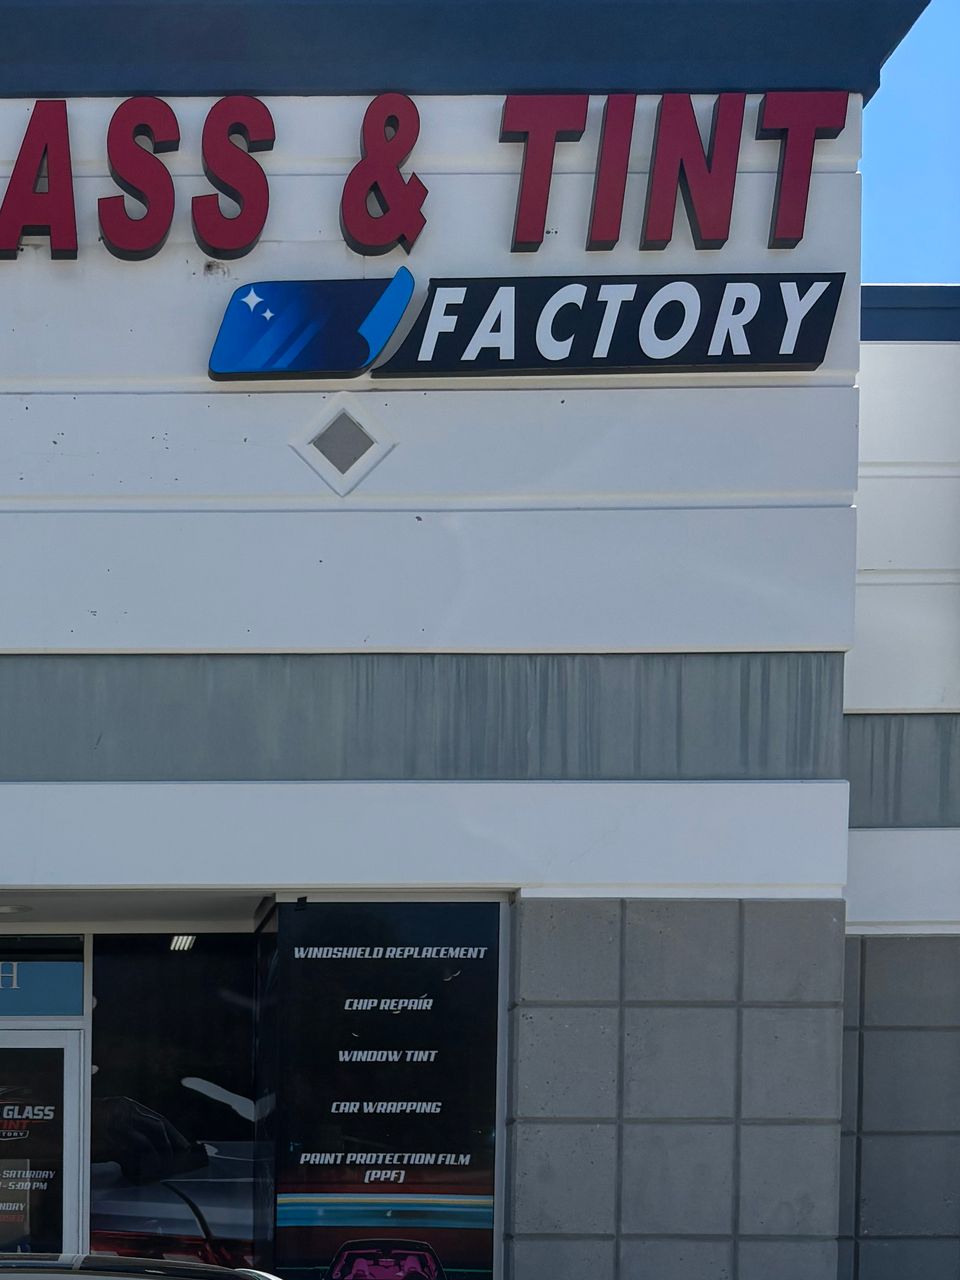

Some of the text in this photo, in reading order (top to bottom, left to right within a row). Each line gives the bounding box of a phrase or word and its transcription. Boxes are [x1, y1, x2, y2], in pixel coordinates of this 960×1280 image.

[340, 92, 430, 256] &
[498, 91, 850, 252] TINT
[418, 281, 832, 362] FACTORY
[294, 946, 488, 959] WINDSHIELD REPLACEMENT
[344, 998, 434, 1011] CHIP REPAIR
[338, 1050, 439, 1062] WINDOW TINT
[2, 1105, 56, 1120] GLASS
[330, 1101, 442, 1114] CAR WRAPPING
[299, 1152, 472, 1166] PAINT PROTECTION FILM
[8, 1181, 31, 1190] 5:00
[32, 1181, 48, 1190] PM
